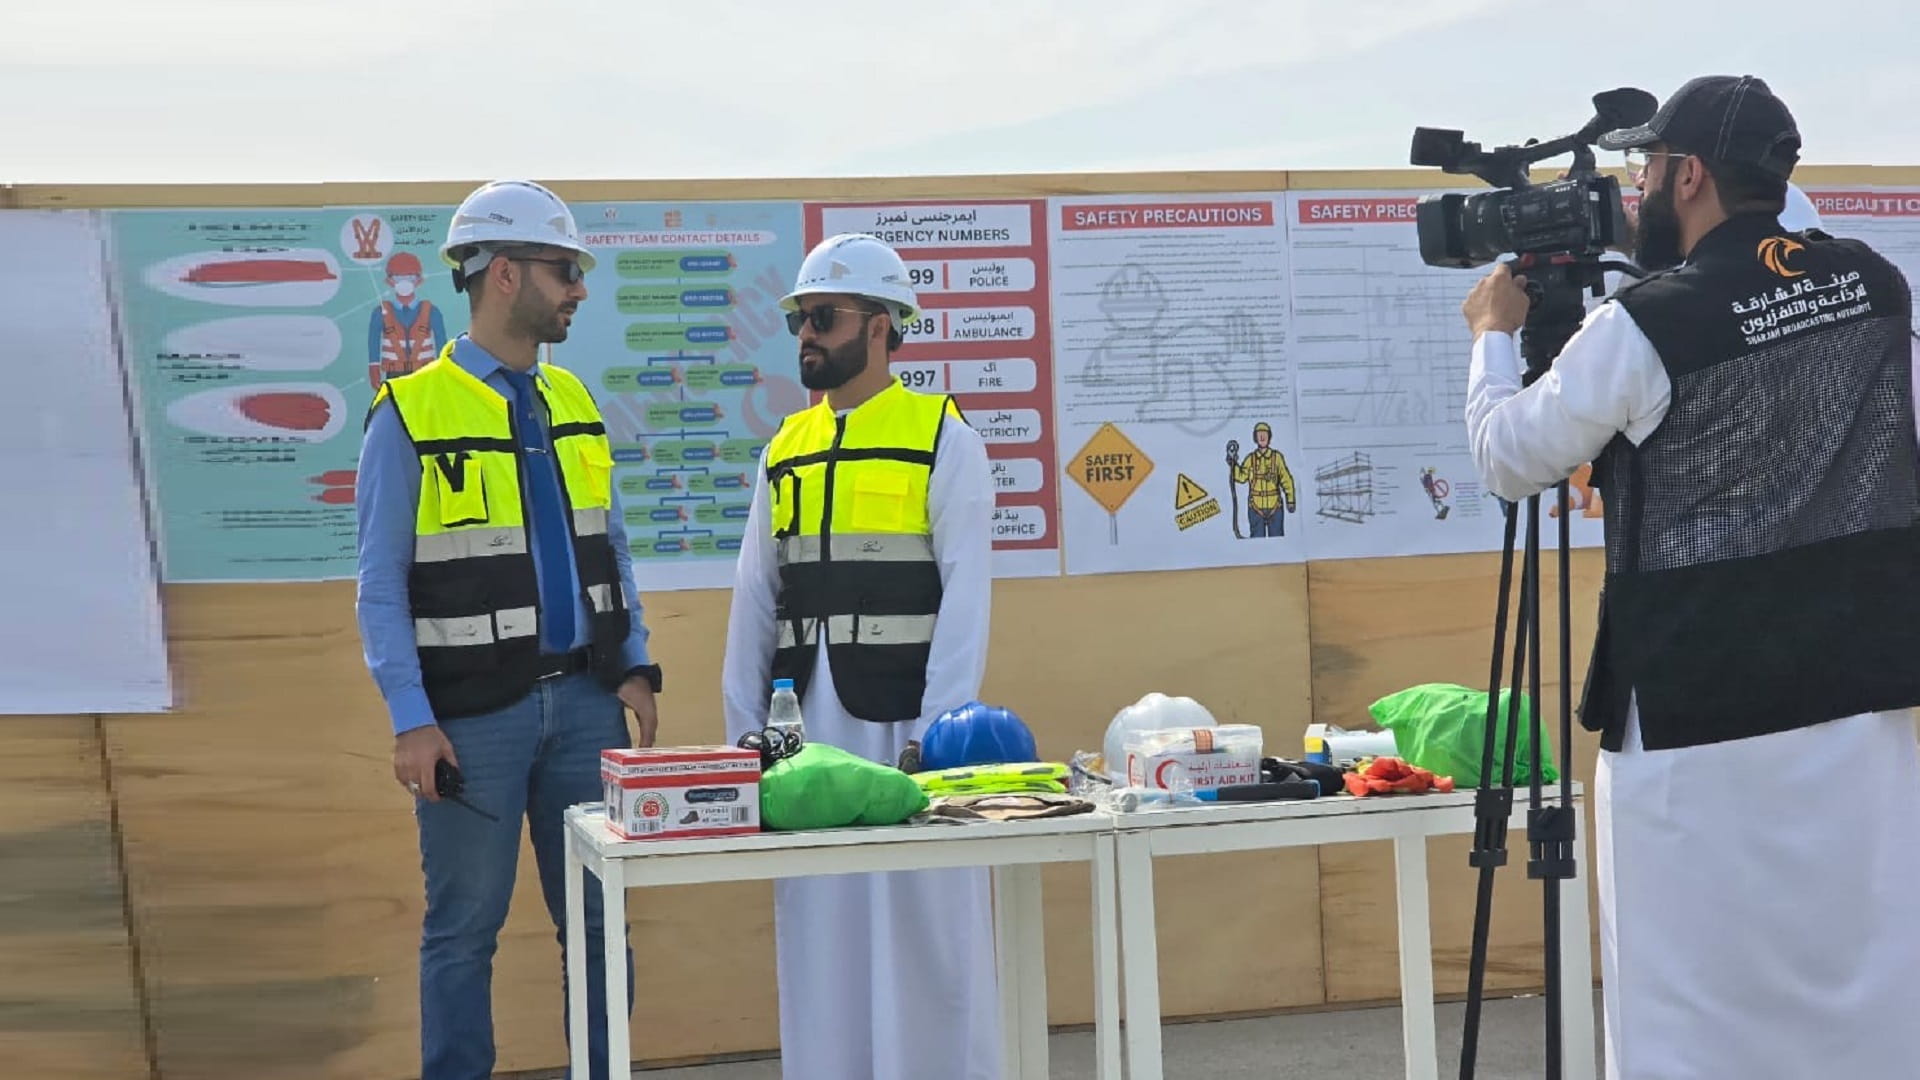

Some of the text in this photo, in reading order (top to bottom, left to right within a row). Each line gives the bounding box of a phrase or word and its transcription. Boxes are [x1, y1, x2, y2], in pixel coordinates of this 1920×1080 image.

[1075, 207, 1263, 226] SAFETY PRECAUTIONS
[1311, 204, 1371, 219] SAFETY
[585, 233, 761, 246] SAFETY TEAM CONTACT DETAILS
[866, 229, 1010, 243] RGENCY NUMBERS
[970, 276, 1009, 287] POLICE
[1731, 282, 1803, 315] الشارقة
[954, 327, 1024, 339] AMBULANCE
[1745, 327, 1782, 346] SHARJAH
[1782, 312, 1836, 337] BROADCASTING
[900, 370, 936, 387] 997
[978, 376, 1003, 388] FIRE
[1085, 453, 1133, 466] SAFETY
[1086, 466, 1135, 483] FIRST
[996, 477, 1016, 488] TER
[1178, 503, 1218, 526] CAUTION
[997, 523, 1037, 536] OFFICE
[1218, 774, 1237, 785] AID
[1239, 773, 1256, 784] KIT
